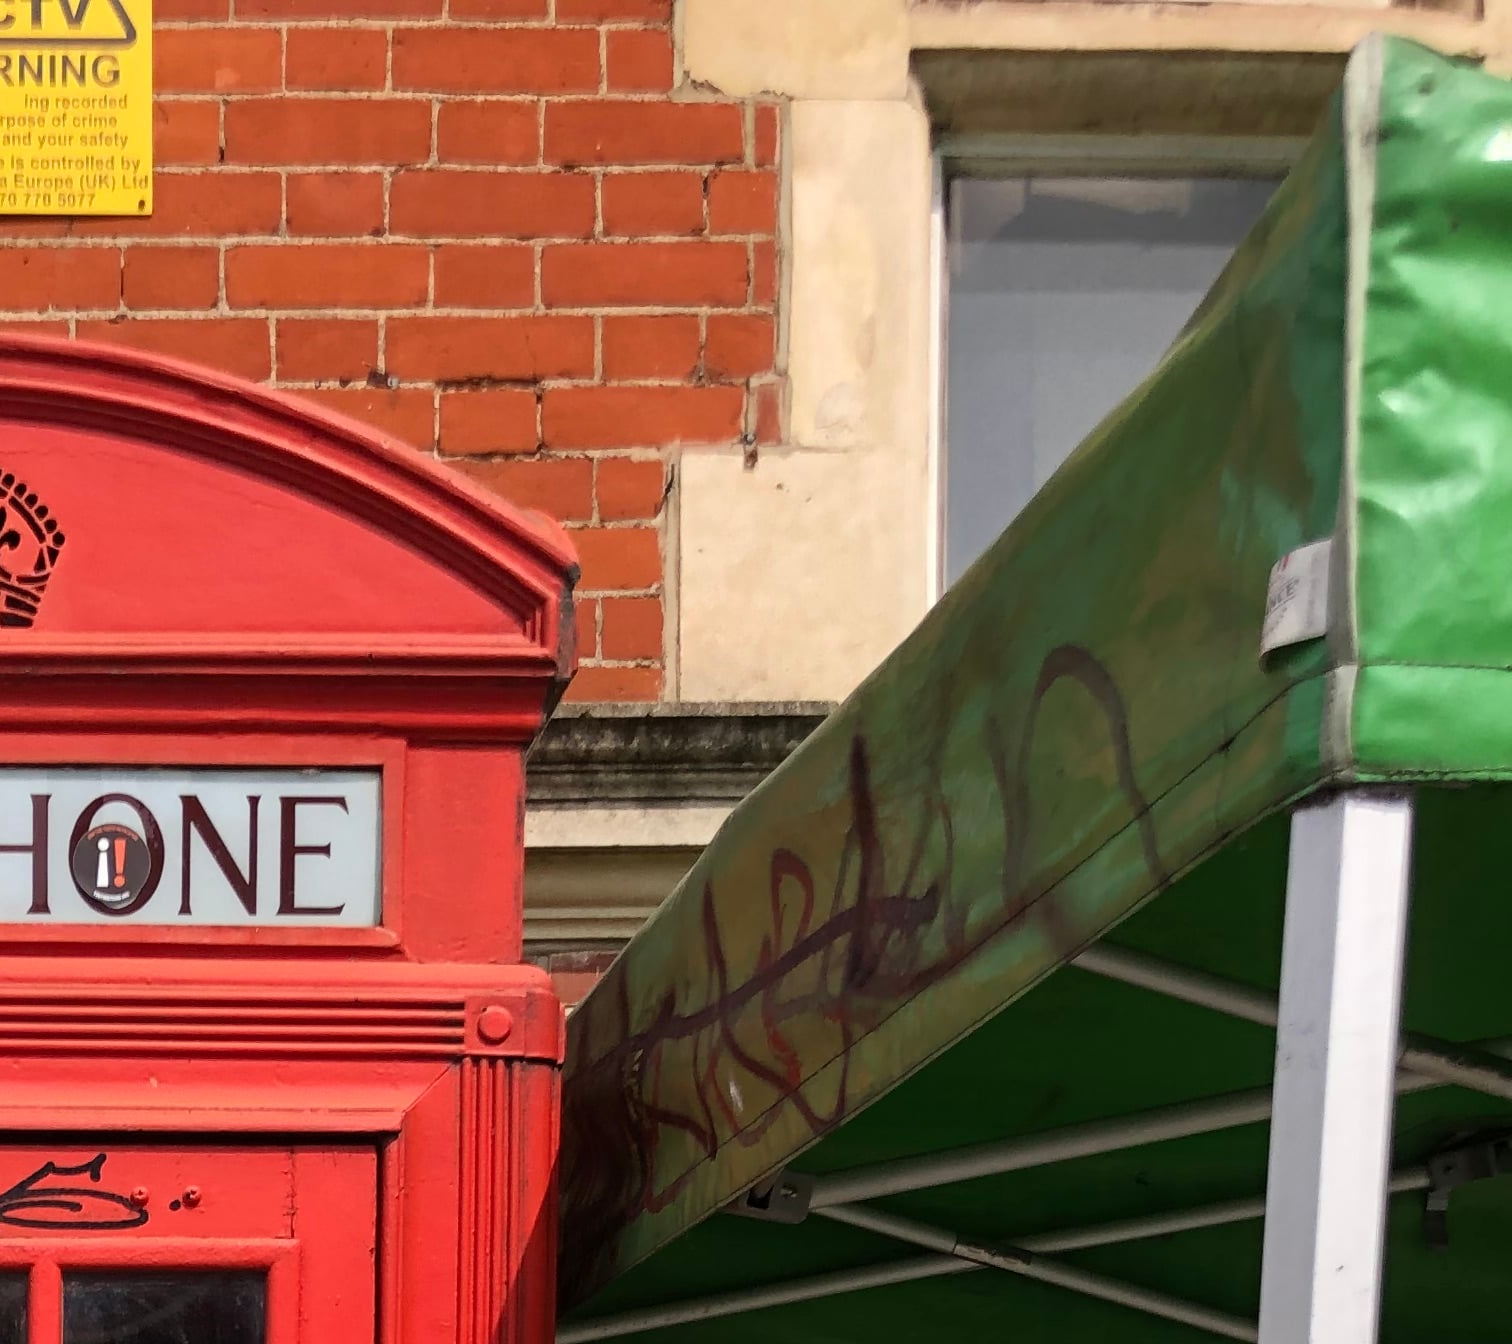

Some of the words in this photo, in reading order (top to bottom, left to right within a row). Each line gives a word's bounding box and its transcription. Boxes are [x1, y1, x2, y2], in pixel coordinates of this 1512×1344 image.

[55, 95, 127, 109] recorded
[51, 113, 68, 126] of
[73, 114, 118, 127] crime
[2, 133, 32, 146] and
[38, 135, 74, 148] your
[80, 133, 128, 148] safety
[11, 156, 24, 169] is
[30, 156, 115, 170] controlled
[121, 157, 140, 173] by
[14, 175, 74, 191] Europe
[79, 175, 116, 191] (UK)
[122, 175, 149, 190] Ltd
